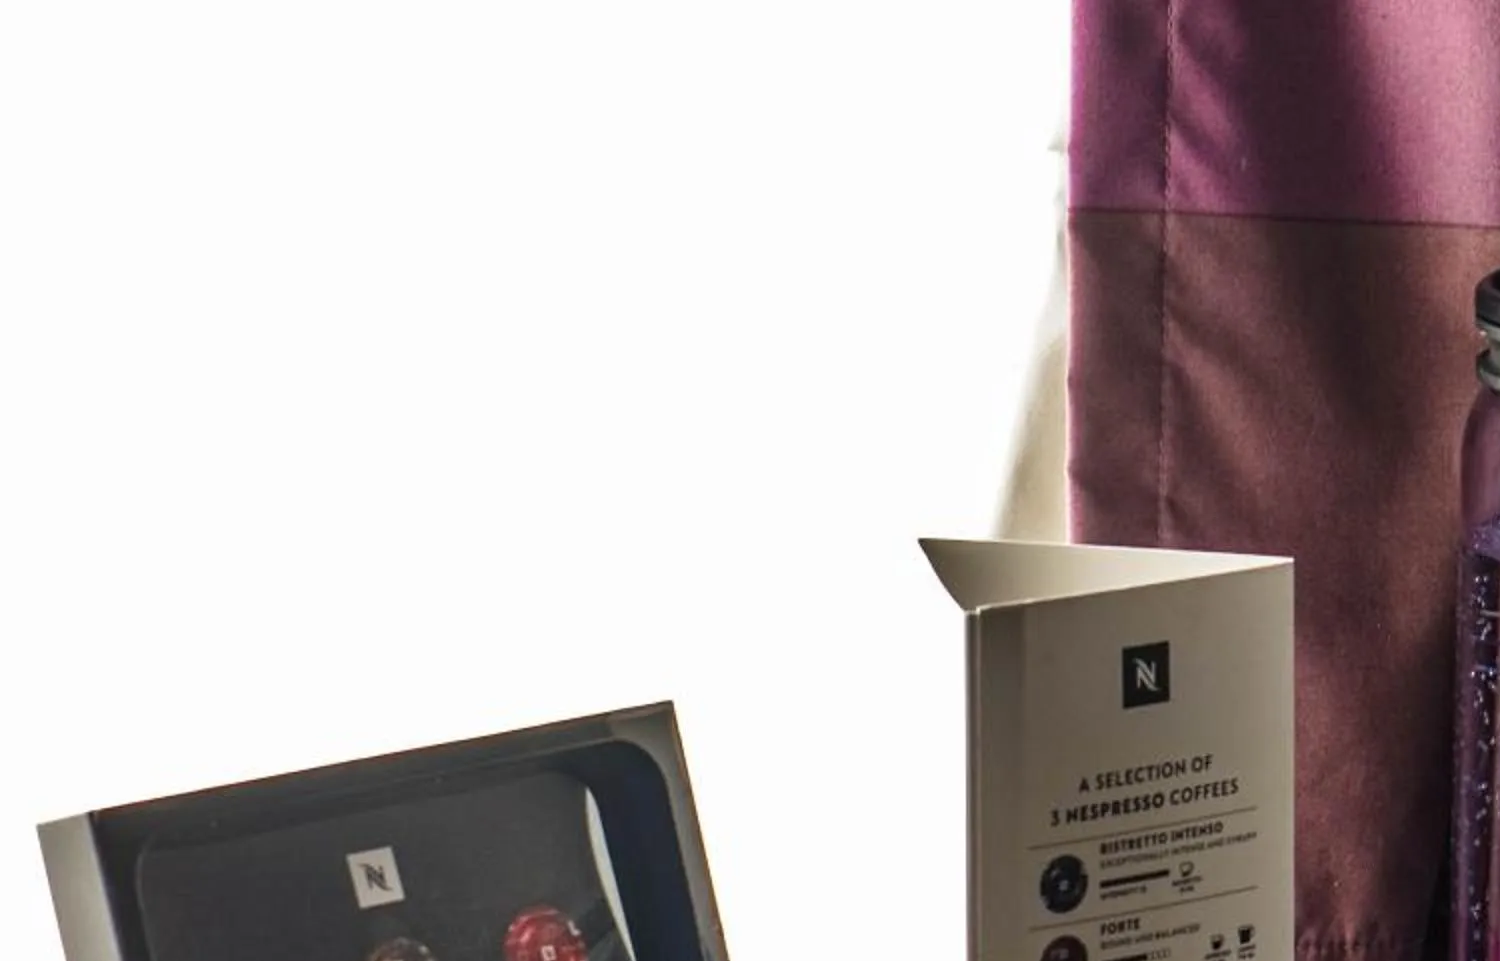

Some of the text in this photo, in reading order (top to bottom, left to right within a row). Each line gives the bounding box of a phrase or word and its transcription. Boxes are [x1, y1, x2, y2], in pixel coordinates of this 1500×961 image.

[1078, 754, 1213, 793] A SELECTION OF
[1050, 777, 1240, 826] 3 NESPRESSO COFFEES
[1100, 821, 1224, 855] RISTRETTO INTENSO
[1100, 917, 1140, 936] FORTE
